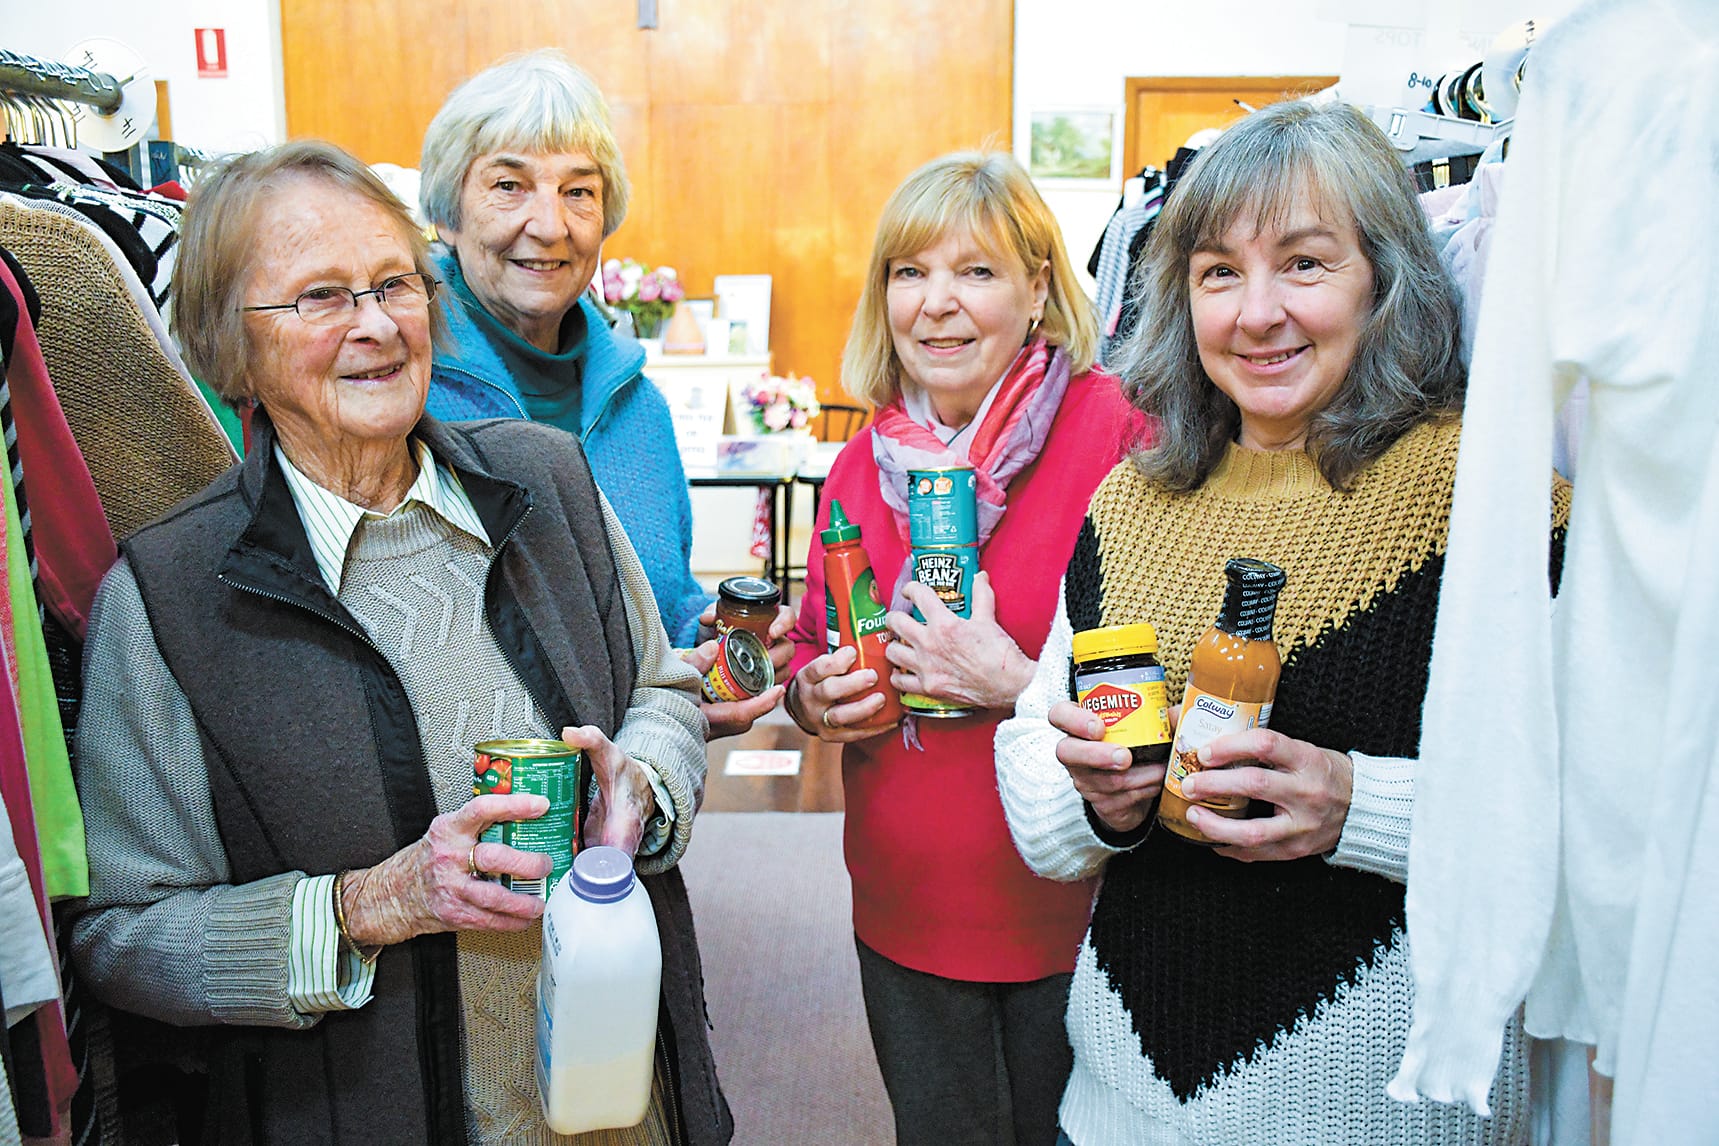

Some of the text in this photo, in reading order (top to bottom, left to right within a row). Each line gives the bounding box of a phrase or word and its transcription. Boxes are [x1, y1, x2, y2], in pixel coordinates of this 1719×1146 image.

[1407, 72, 1432, 89] 8-10
[921, 557, 953, 569] HEINZ
[918, 568, 961, 584] BEANZ
[1196, 698, 1235, 718] Colway
